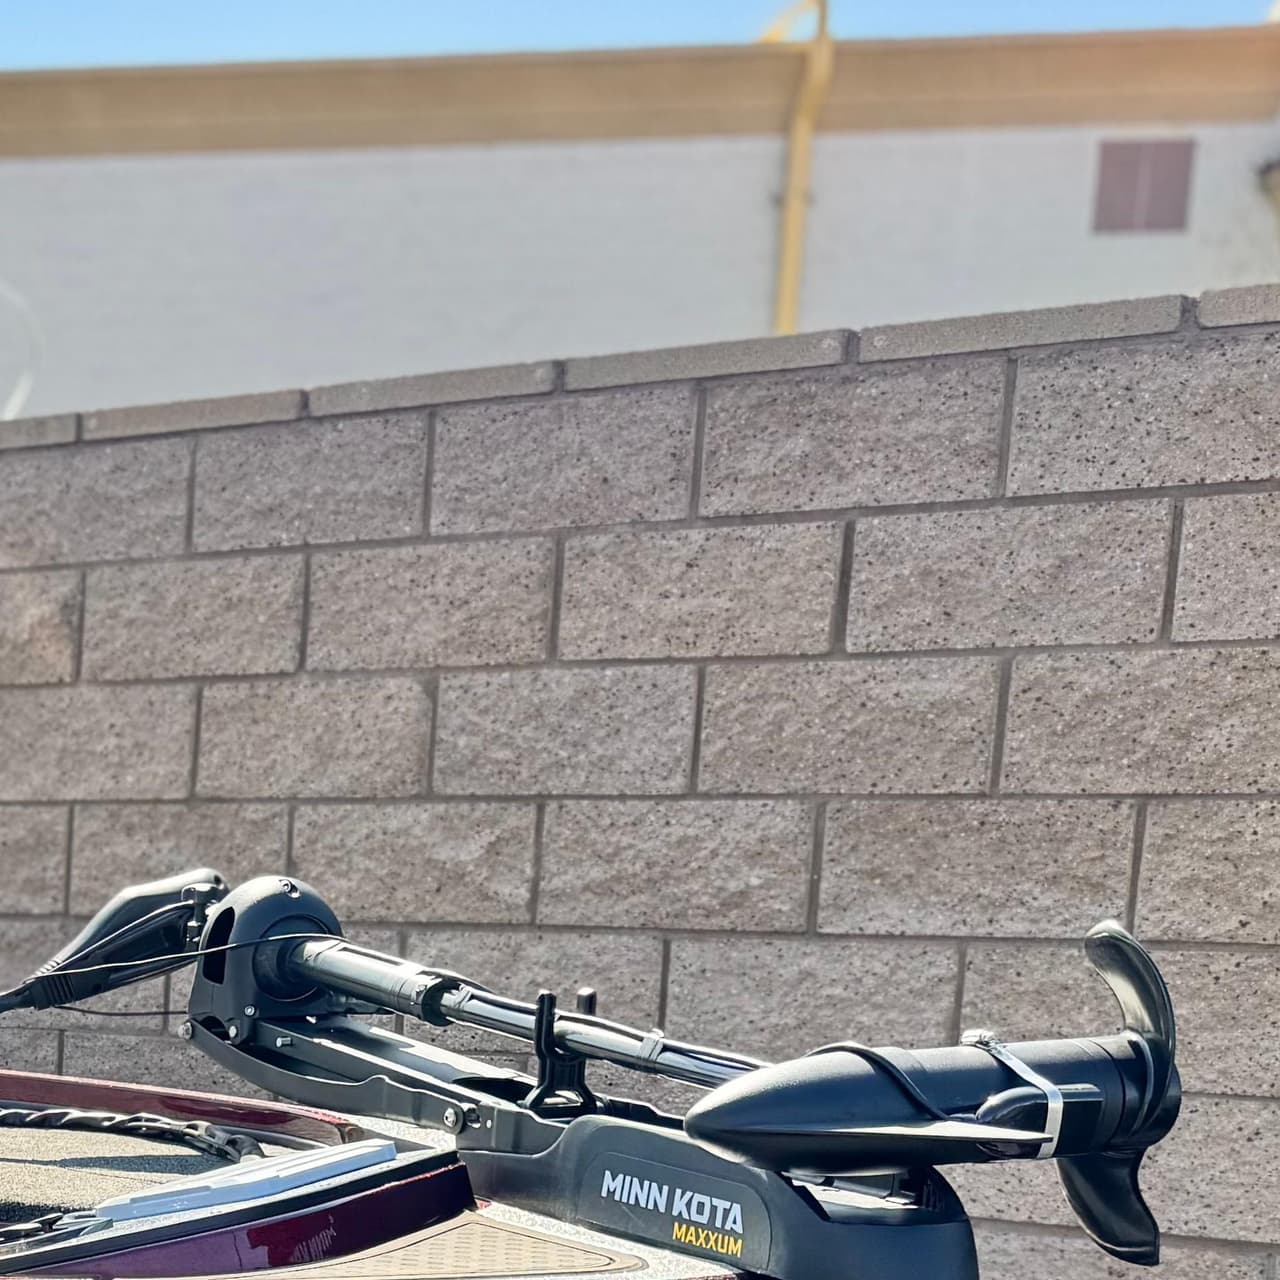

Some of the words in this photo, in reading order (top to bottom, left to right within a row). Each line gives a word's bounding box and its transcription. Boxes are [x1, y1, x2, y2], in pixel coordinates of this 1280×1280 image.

[601, 1170, 669, 1213] MINN
[672, 1188, 744, 1234] KOTA
[672, 1221, 743, 1258] MAXXUM
